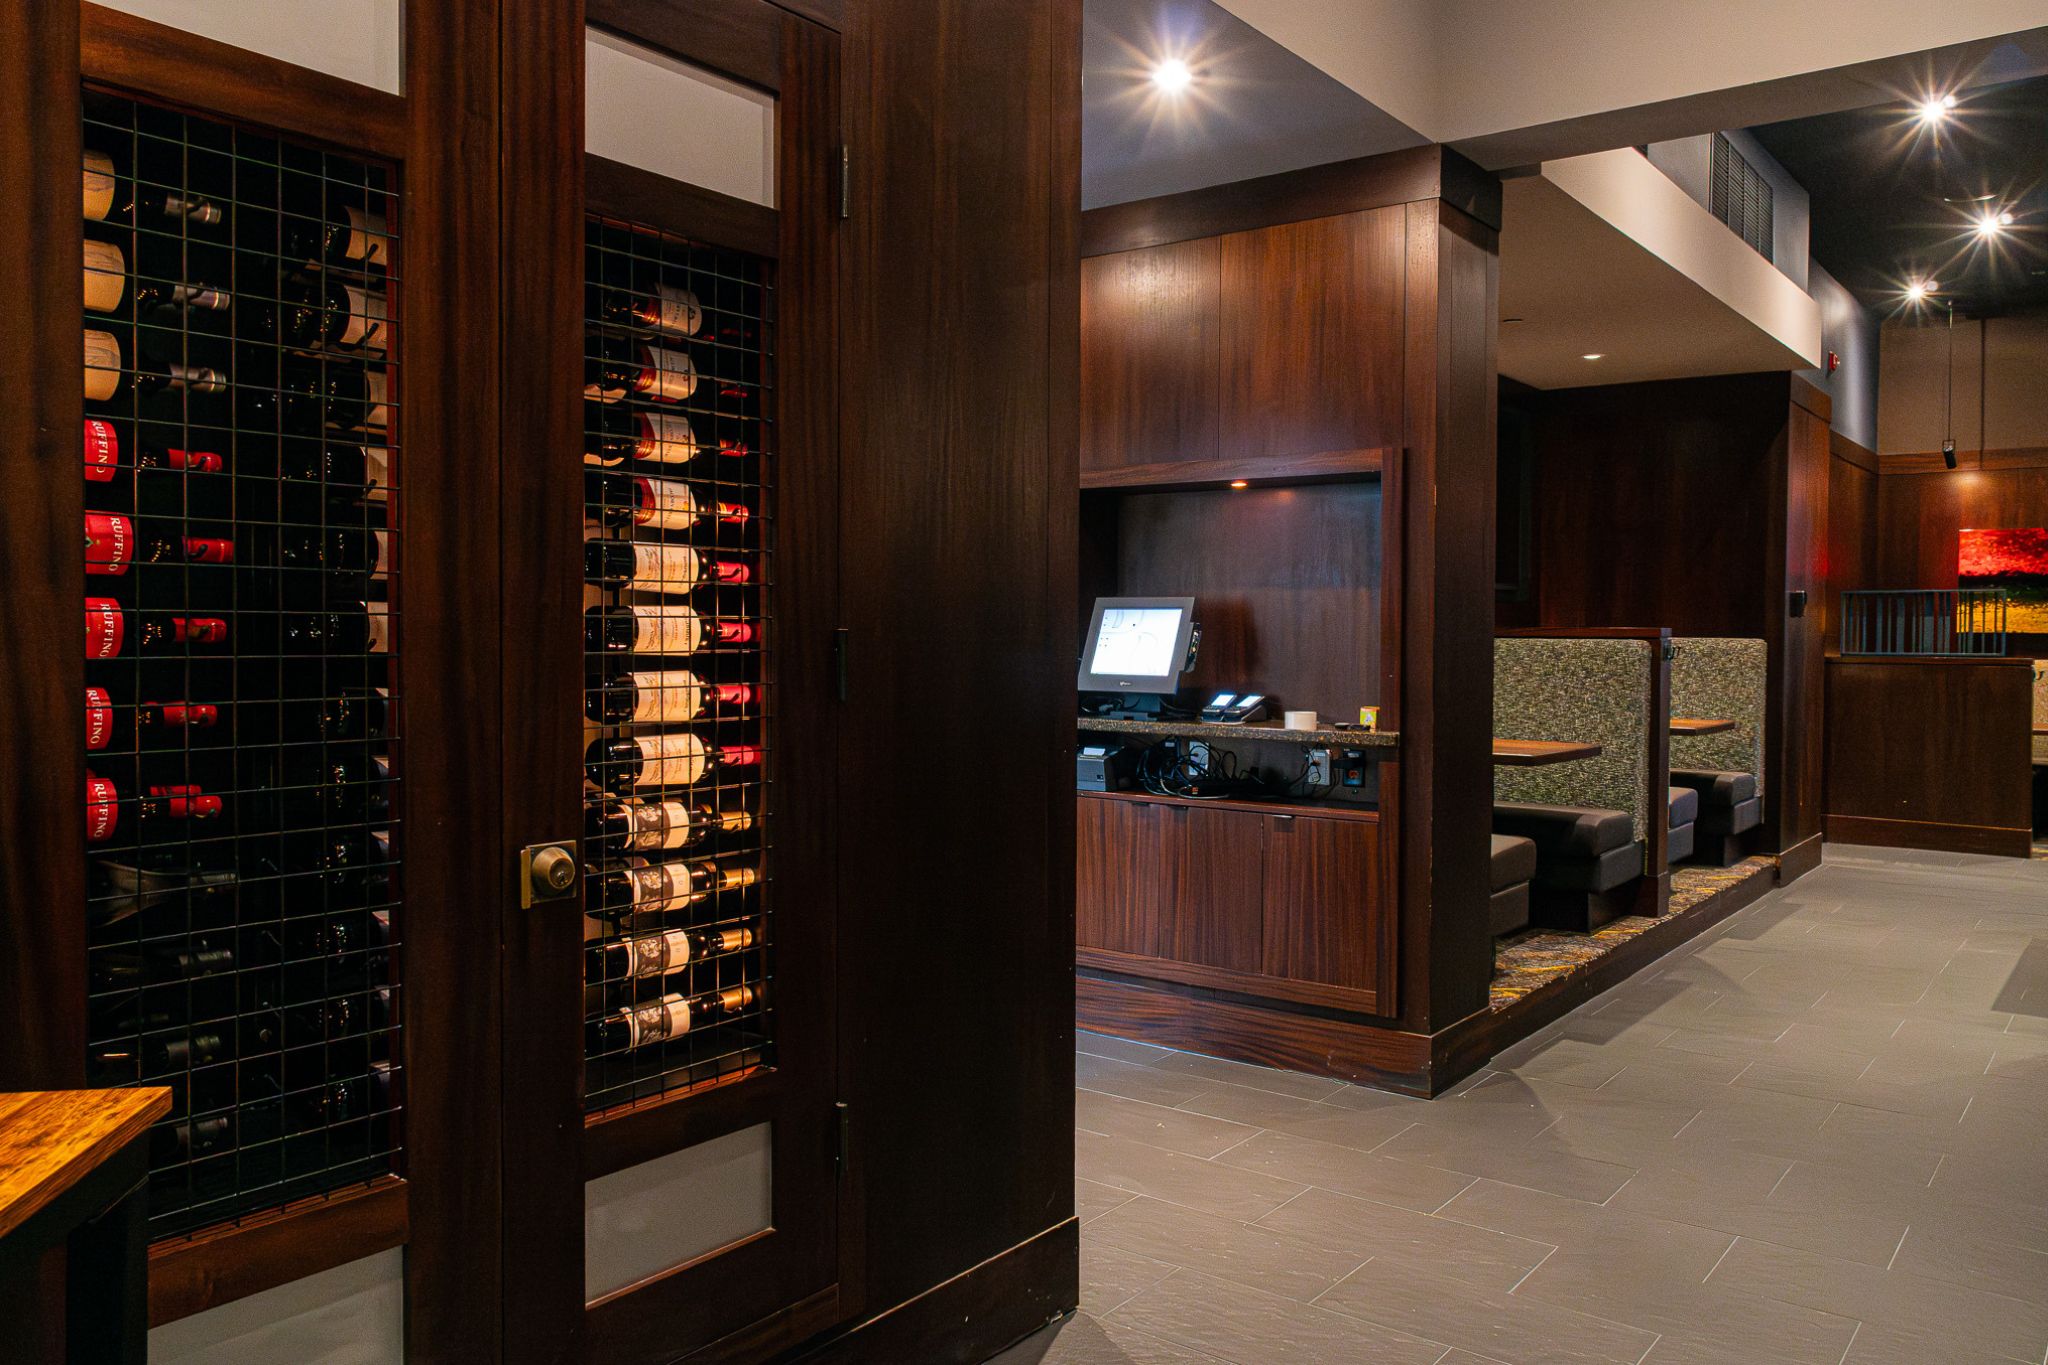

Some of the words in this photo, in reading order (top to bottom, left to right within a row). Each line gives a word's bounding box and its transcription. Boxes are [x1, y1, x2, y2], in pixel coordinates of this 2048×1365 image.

[108, 517, 124, 572] RUFFINO
[99, 603, 114, 658] RUFFINO
[94, 783, 109, 839] RUFFINO
